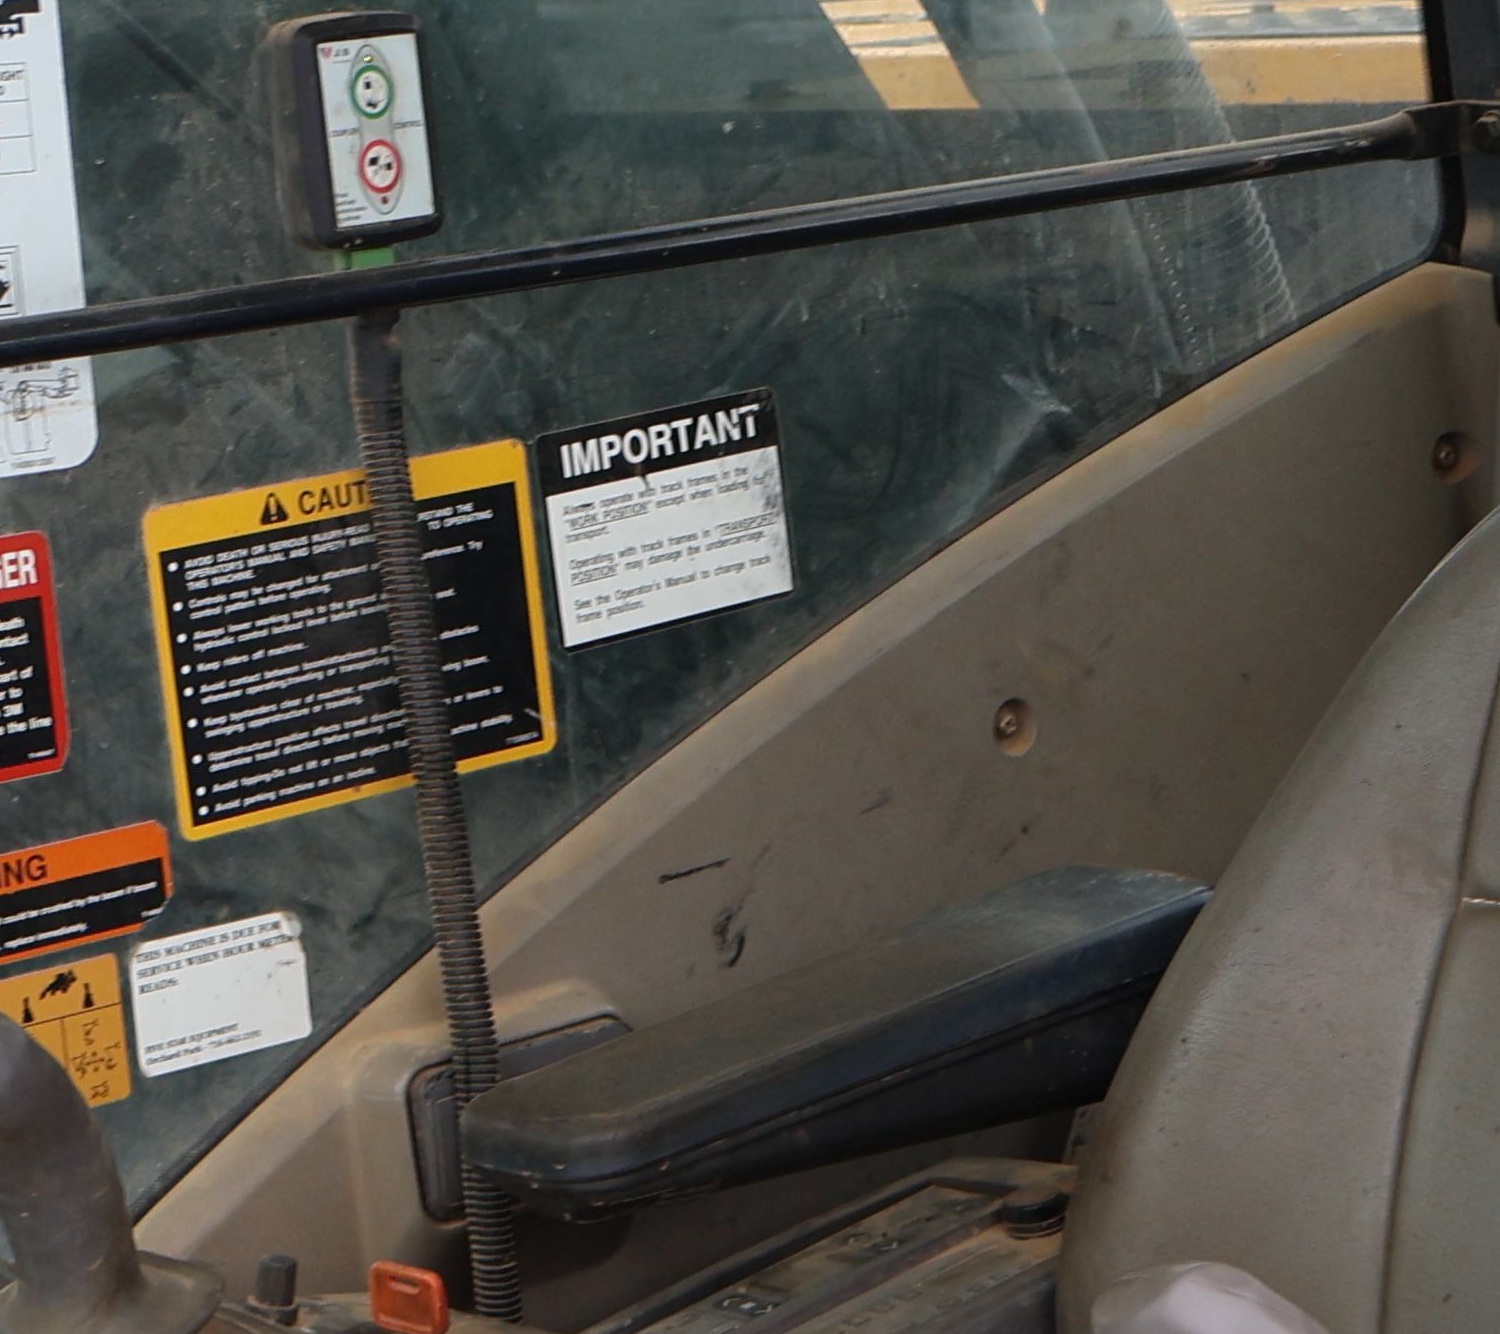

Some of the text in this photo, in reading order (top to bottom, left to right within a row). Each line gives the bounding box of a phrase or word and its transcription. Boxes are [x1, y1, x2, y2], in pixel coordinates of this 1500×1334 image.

[561, 405, 757, 476] IMPORTANT
[298, 479, 376, 516] CAUT
[563, 465, 749, 515] Always operate with track frames in the
[716, 478, 750, 494] loading
[426, 509, 493, 530] TO OPERATING
[455, 502, 474, 513] THE
[564, 488, 714, 529] "WORK POSITION" except when
[564, 525, 610, 544] transport.
[570, 530, 767, 586] POSITION" may damage the undercarriage.
[573, 554, 771, 611] See the Operator's Manual to change track
[575, 600, 646, 624] frame position.
[19, 665, 33, 679] of
[8, 686, 23, 699] to
[2, 702, 23, 717] 3M
[6, 721, 27, 734] the
[28, 716, 53, 729] line
[134, 920, 281, 963] THIS MACHINE IS DUE FOR
[137, 959, 182, 979] SERVICE
[186, 951, 219, 966] WHEN
[222, 942, 254, 958] HOUR
